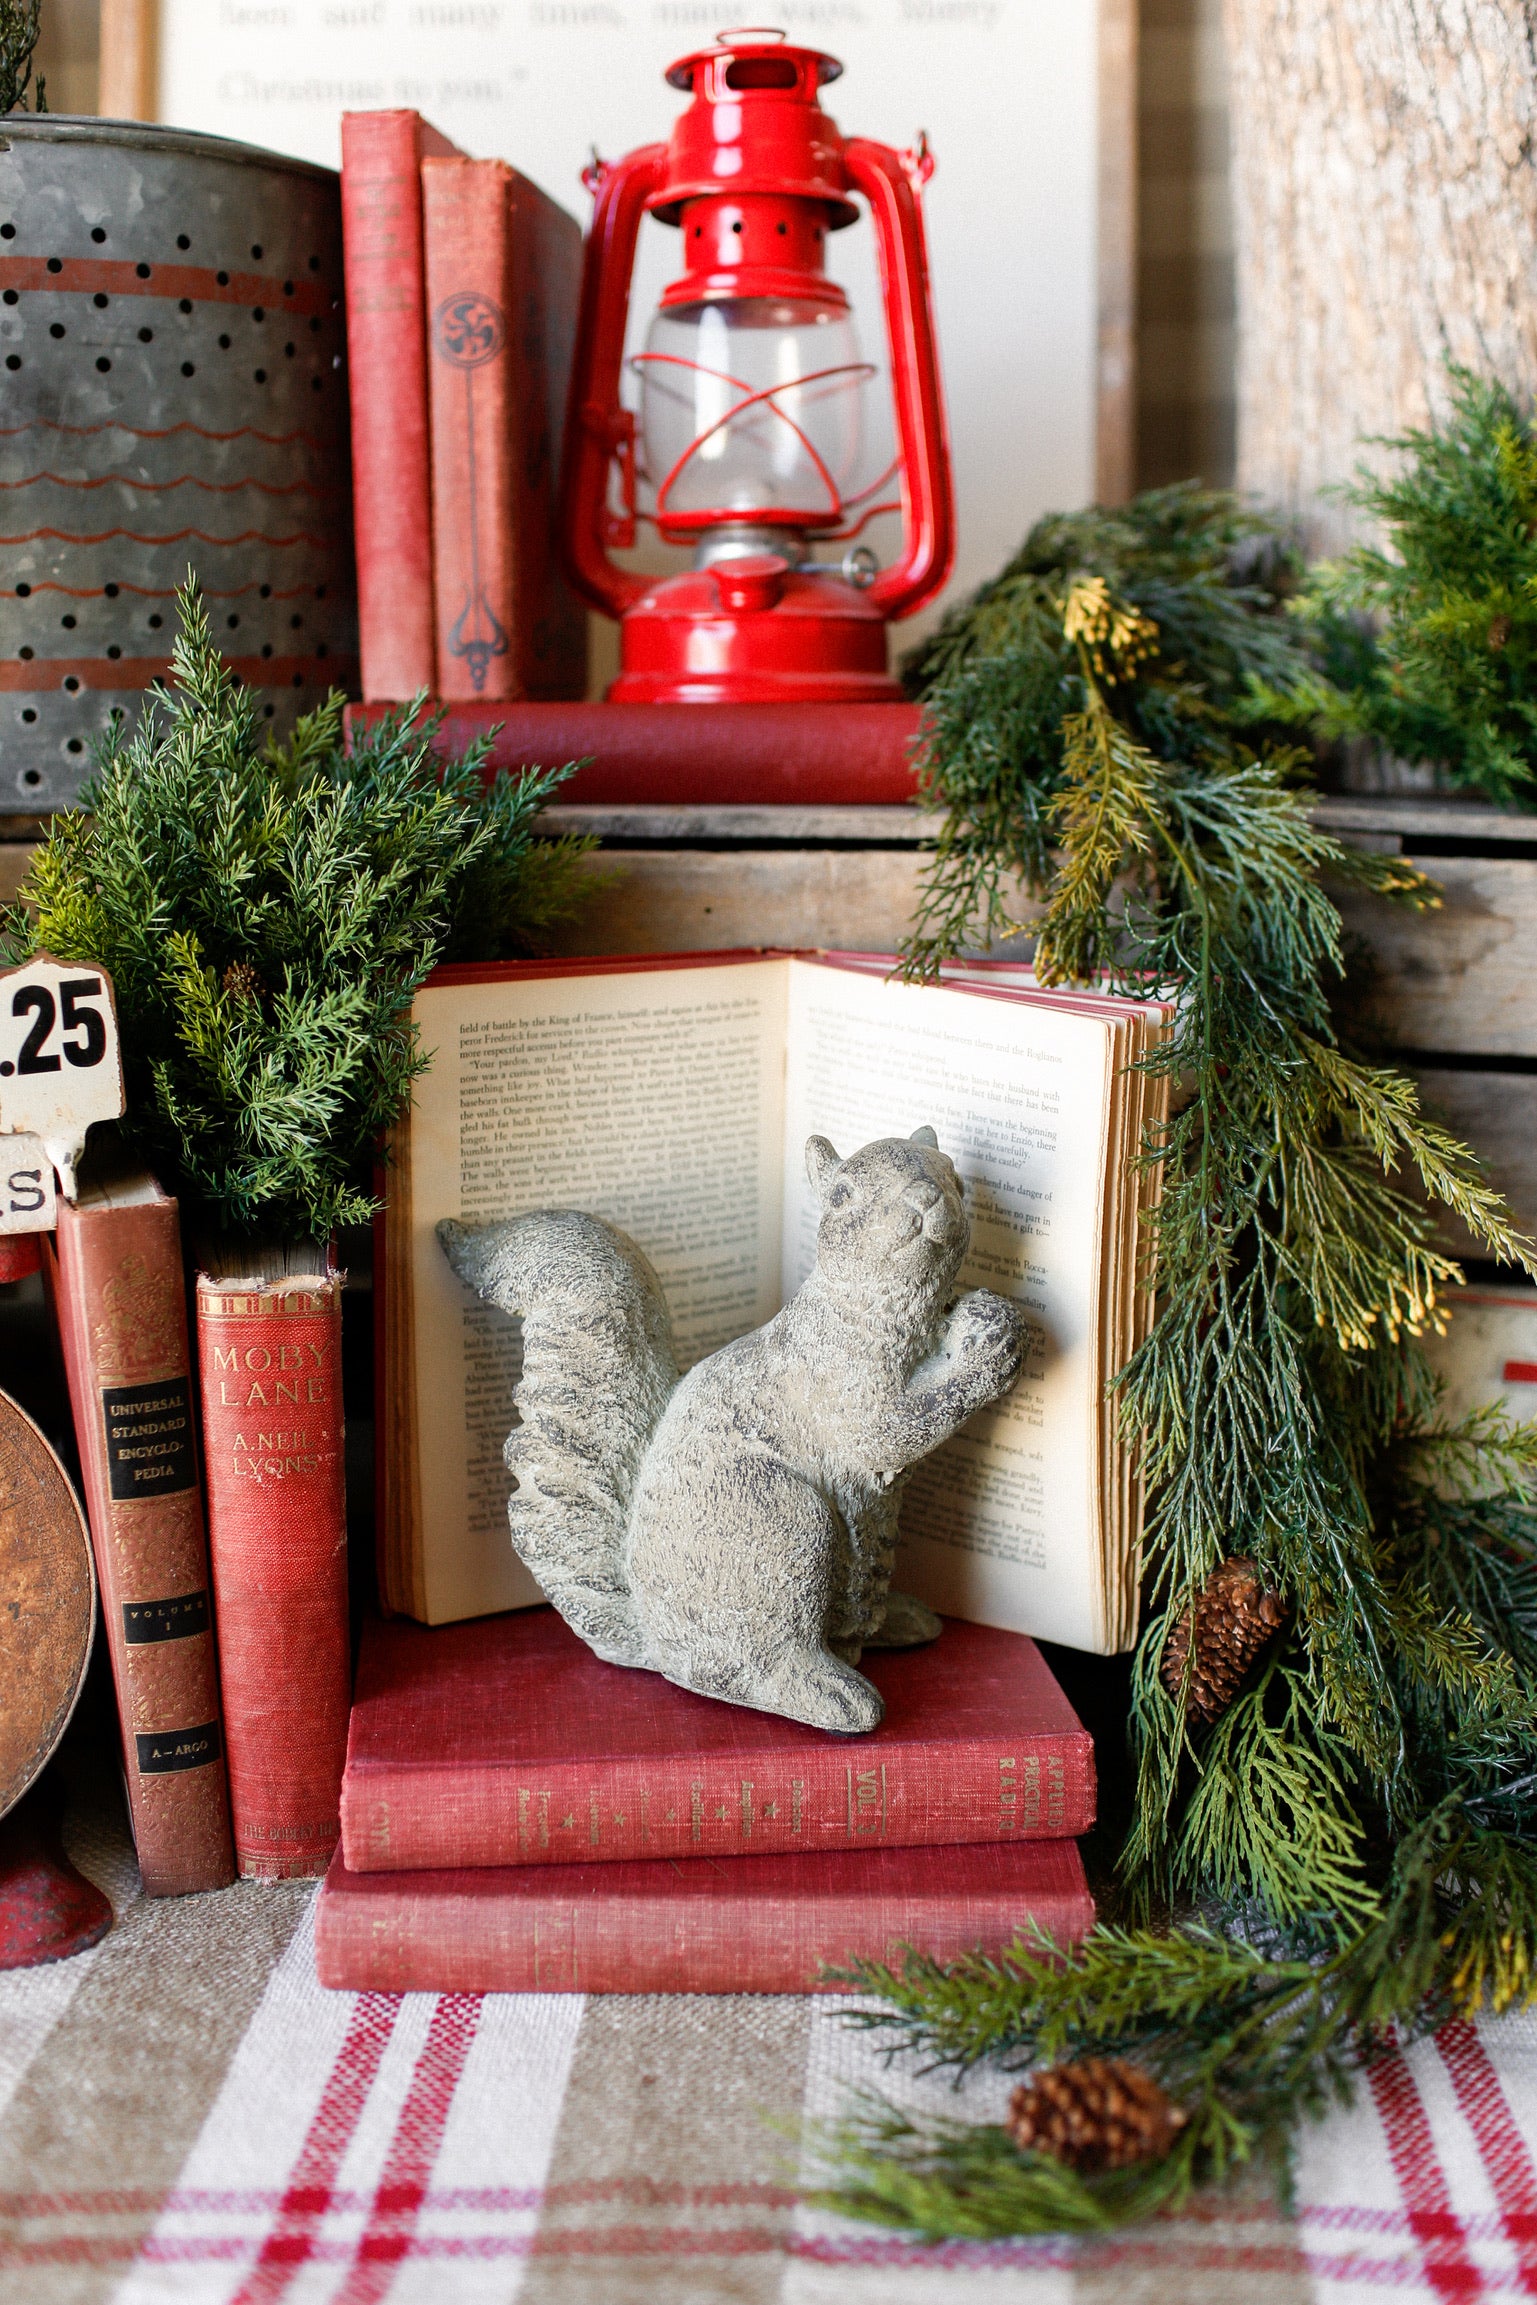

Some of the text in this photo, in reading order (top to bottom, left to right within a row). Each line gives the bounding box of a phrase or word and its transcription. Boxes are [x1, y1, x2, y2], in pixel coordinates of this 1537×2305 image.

[0, 977, 107, 1076] .25
[460, 1022, 478, 1034] field
[481, 1022, 490, 1031] of
[493, 1019, 516, 1031] battle
[519, 1018, 529, 1029] by
[532, 1016, 546, 1027] the
[549, 1015, 569, 1027] King
[460, 1038, 482, 1049] peror
[485, 1031, 524, 1044] Frederick
[527, 1031, 538, 1040] for
[541, 1029, 572, 1038] services
[975, 1036, 994, 1050] them
[996, 1043, 1010, 1054] and
[1012, 1045, 1025, 1056] the
[460, 1049, 481, 1059] more
[484, 1043, 524, 1057] respectful
[527, 1041, 557, 1052] accents
[460, 1075, 478, 1084] now
[481, 1072, 498, 1081] was
[509, 1068, 541, 1079] curious
[460, 1082, 504, 1096] something
[507, 1080, 523, 1091] like
[1008, 1081, 1040, 1097] husband
[1043, 1091, 1060, 1102] with
[460, 1095, 497, 1108] baseborn
[500, 1091, 543, 1105] innkeeper
[971, 1086, 985, 1098] fact
[987, 1091, 1002, 1102] that
[1004, 1093, 1024, 1107] there
[1026, 1097, 1039, 1109] has
[1041, 1100, 1059, 1114] been
[460, 1110, 474, 1120] the
[503, 1106, 523, 1116] One
[525, 1105, 546, 1114] more
[460, 1122, 478, 1135] gled
[482, 1120, 494, 1131] his
[498, 1119, 509, 1129] fat
[495, 1127, 558, 1142] He owned his
[966, 1109, 1057, 1142] There was the beginning
[987, 1126, 999, 1139] her
[1011, 1132, 1034, 1148] Enzio,
[1036, 1138, 1057, 1152] there
[461, 1145, 493, 1157] humble
[495, 1145, 504, 1154] in
[506, 1142, 526, 1153] their
[985, 1151, 997, 1163] the
[996, 1142, 1031, 1160] carefully.
[461, 1159, 480, 1169] than
[483, 1159, 499, 1170] any
[502, 1154, 533, 1167] peasant
[462, 1171, 478, 1182] The
[483, 1168, 505, 1179] walls
[496, 1180, 509, 1190] the
[1003, 1181, 1016, 1193] the
[1017, 1183, 1043, 1200] danger
[995, 1202, 1012, 1216] have
[1014, 1211, 1024, 1220] no
[1025, 1214, 1041, 1224] part
[1020, 1223, 1033, 1234] gift
[1003, 1256, 1021, 1267] with
[994, 1264, 1009, 1277] that
[1012, 1269, 1024, 1280] his
[213, 1341, 333, 1372] MOBY
[219, 1377, 326, 1407] LANE
[110, 1396, 185, 1417] UNIVERSAL
[112, 1417, 186, 1439] STANDARD
[118, 1441, 184, 1460] ENCYCLO-
[134, 1465, 175, 1481] PEDIA
[233, 1455, 318, 1476] LYONS
[130, 1600, 204, 1620] VOLUME
[998, 1757, 1017, 1831] RADIO
[1023, 1755, 1041, 1830] PRACTICAL
[1047, 1755, 1065, 1828] APPLIED
[691, 1781, 706, 1841] Oscillators
[740, 1780, 755, 1839] Amplifiers
[791, 1779, 805, 1835] Detectors
[856, 1769, 877, 1836] VOL. 3
[244, 1823, 266, 1840] THE
